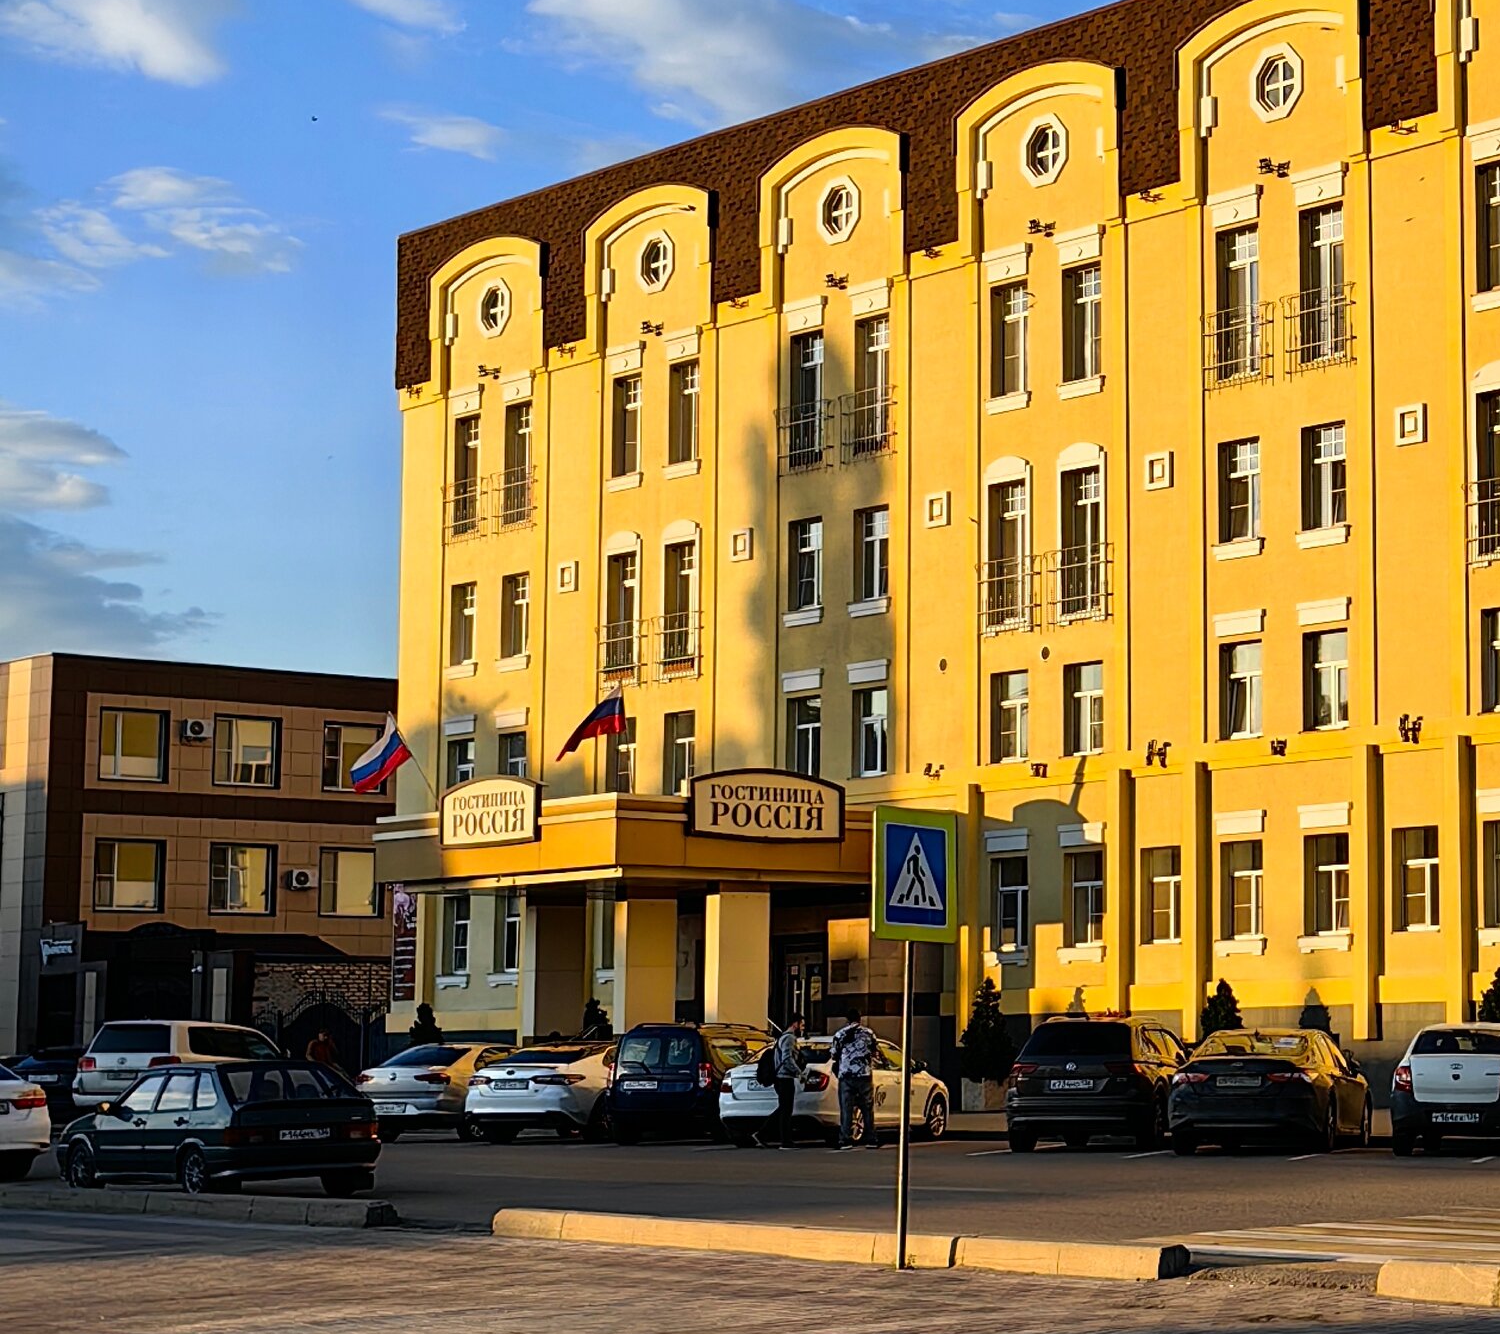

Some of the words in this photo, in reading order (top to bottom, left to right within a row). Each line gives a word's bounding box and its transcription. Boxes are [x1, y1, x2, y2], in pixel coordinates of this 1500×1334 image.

[453, 790, 525, 811] ГОСТИНИЦА
[710, 784, 824, 806] ГОСТИНИЦА
[453, 808, 524, 837] РОССІЯ
[710, 801, 823, 830] РОССІЯ
